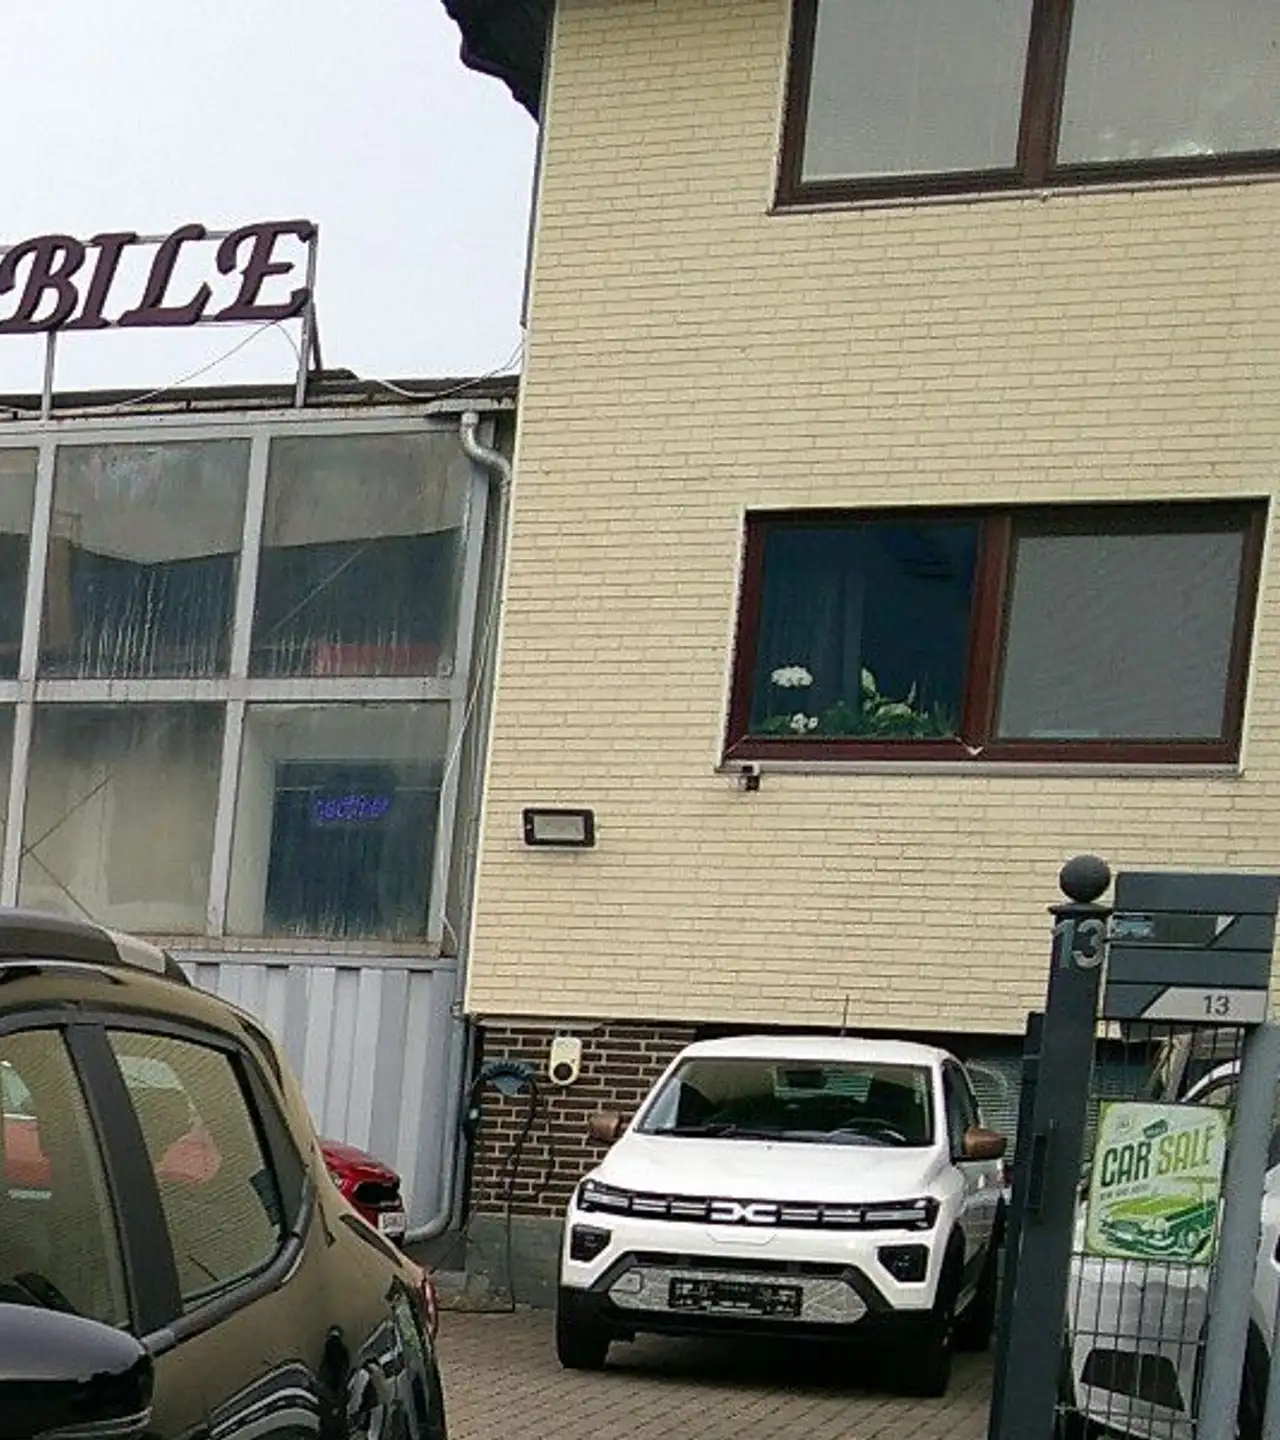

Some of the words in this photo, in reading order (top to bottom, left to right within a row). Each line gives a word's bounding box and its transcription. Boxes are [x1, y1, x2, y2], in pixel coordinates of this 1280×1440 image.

[1051, 918, 1107, 970] 13
[1203, 995, 1230, 1015] 13
[1100, 1141, 1152, 1187] CAR
[1158, 1124, 1217, 1174] SALE
